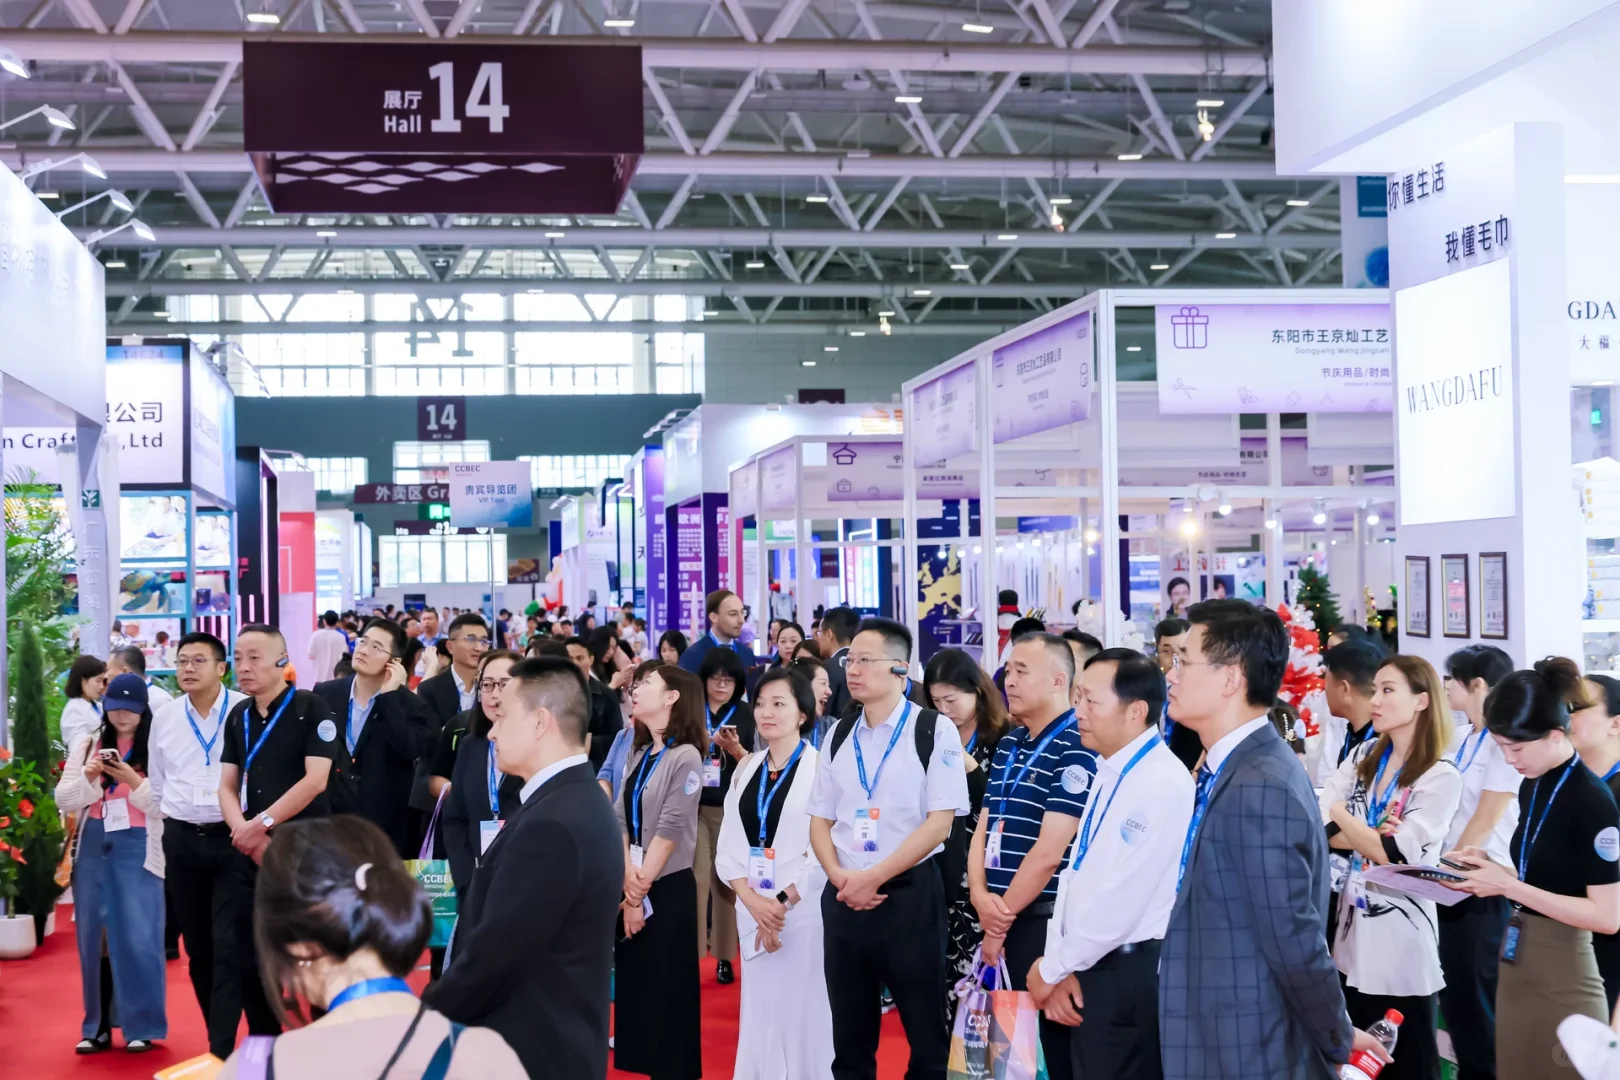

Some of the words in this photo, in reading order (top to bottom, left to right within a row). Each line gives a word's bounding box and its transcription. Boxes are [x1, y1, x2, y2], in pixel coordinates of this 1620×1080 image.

[383, 90, 422, 109] 展厅
[428, 61, 510, 133] 14
[384, 115, 422, 133] Hall
[1388, 161, 1444, 211] 你懂生活
[1445, 213, 1508, 263] 我懂毛巾
[1567, 300, 1620, 320] GDA
[1272, 329, 1389, 343] 东阳市王京灿工艺
[1407, 365, 1502, 415] WANGDAFU
[426, 404, 457, 430] 14
[427, 485, 450, 499] Gr
[465, 484, 517, 495] 贵宾导览团
[1066, 769, 1086, 787] CCBEC
[1125, 818, 1147, 833] CCBEC
